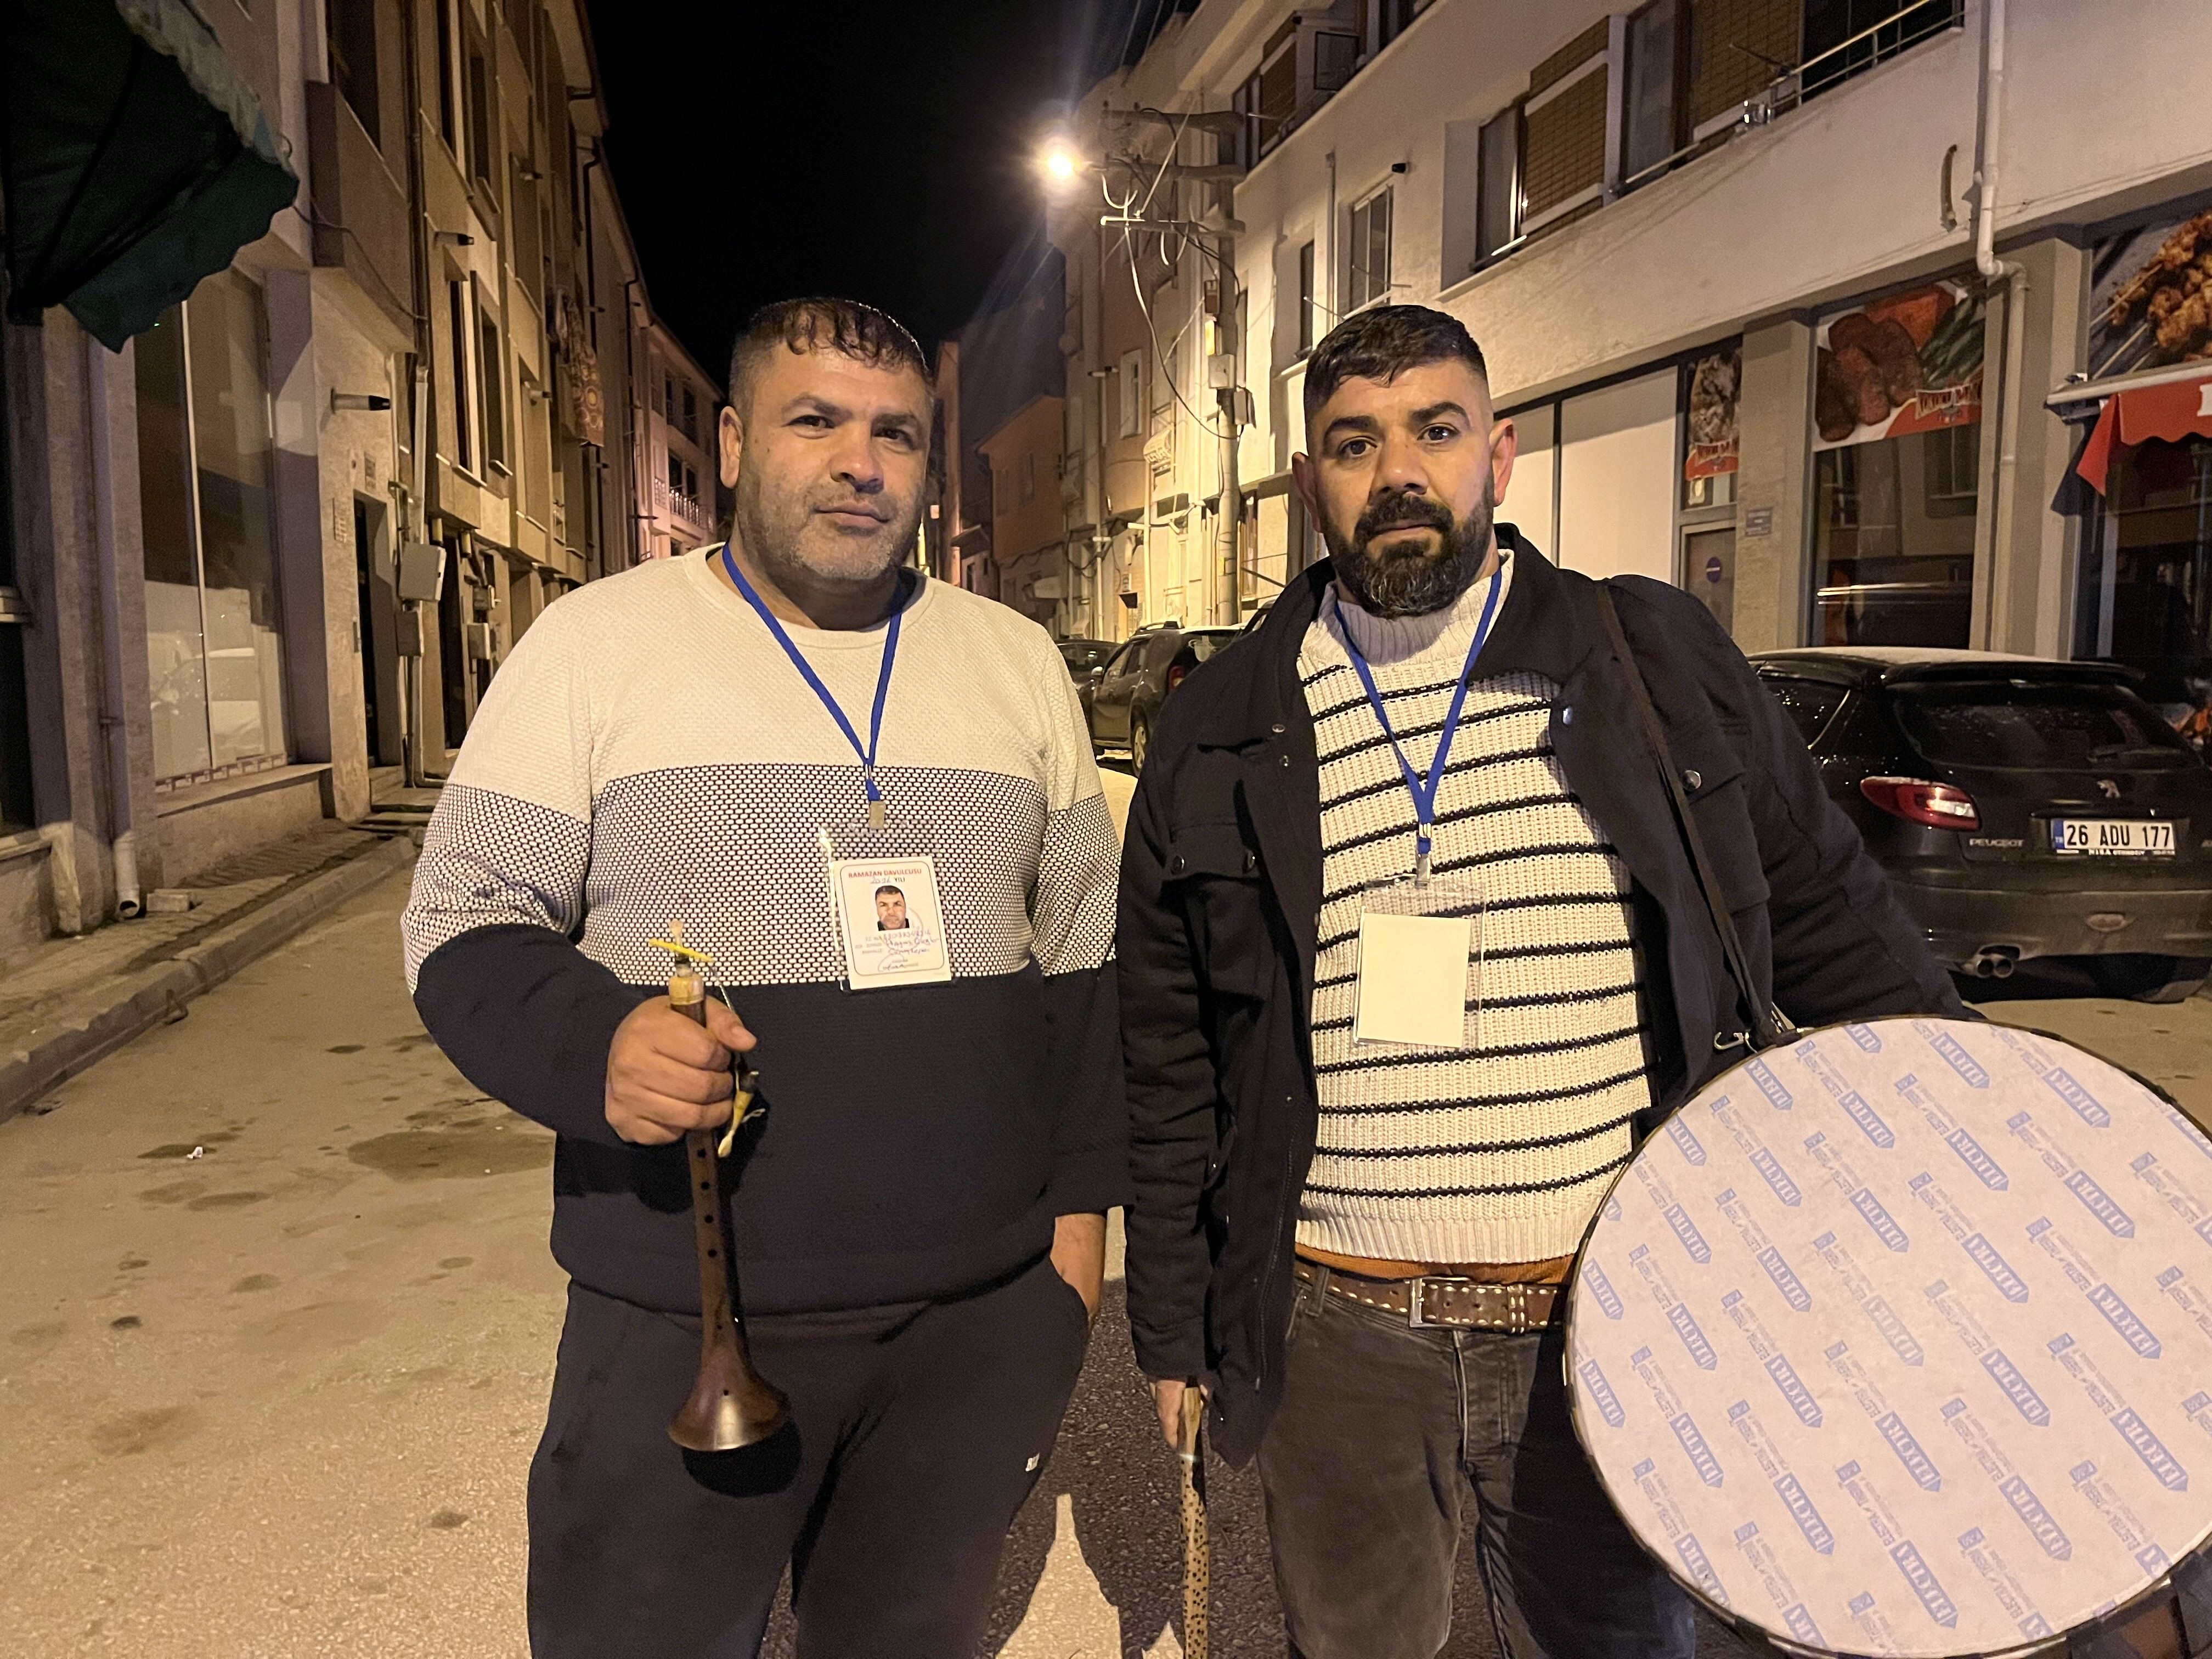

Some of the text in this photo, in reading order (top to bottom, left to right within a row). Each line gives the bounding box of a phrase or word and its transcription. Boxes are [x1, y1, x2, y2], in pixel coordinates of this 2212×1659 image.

[1970, 838, 2023, 847] PEUGEOT
[2067, 825, 2170, 847] 26 ADU 177
[1933, 1035, 1985, 1084] ELECTRA
[1841, 1093, 1890, 1143] ELECTRA
[2046, 1070, 2105, 1122] ELECTRA
[1752, 1150, 1797, 1201] ELECTRA
[1948, 1131, 2003, 1185] ELECTRA
[1853, 1190, 1904, 1246] ELECTRA
[2067, 1173, 2129, 1232] ELECTRA
[1666, 1206, 1707, 1259] ELECTRA
[1760, 1249, 1807, 1305] ELECTRA
[1965, 1236, 2023, 1296] ELECTRA
[1669, 1306, 1712, 1363] ELECTRA
[2090, 1286, 2154, 1352] ELECTRA
[1768, 1357, 1818, 1420] ELECTRA
[1983, 1351, 2044, 1419] ELECTRA
[1673, 1415, 1719, 1480] ELECTRA
[1879, 1415, 1936, 1483] ELECTRA
[2114, 1410, 2181, 1483] ELECTRA
[1777, 1476, 1829, 1546] ELECTRA
[2002, 1478, 2066, 1552] ELECTRA
[1893, 1543, 1952, 1619] ELECTRA
